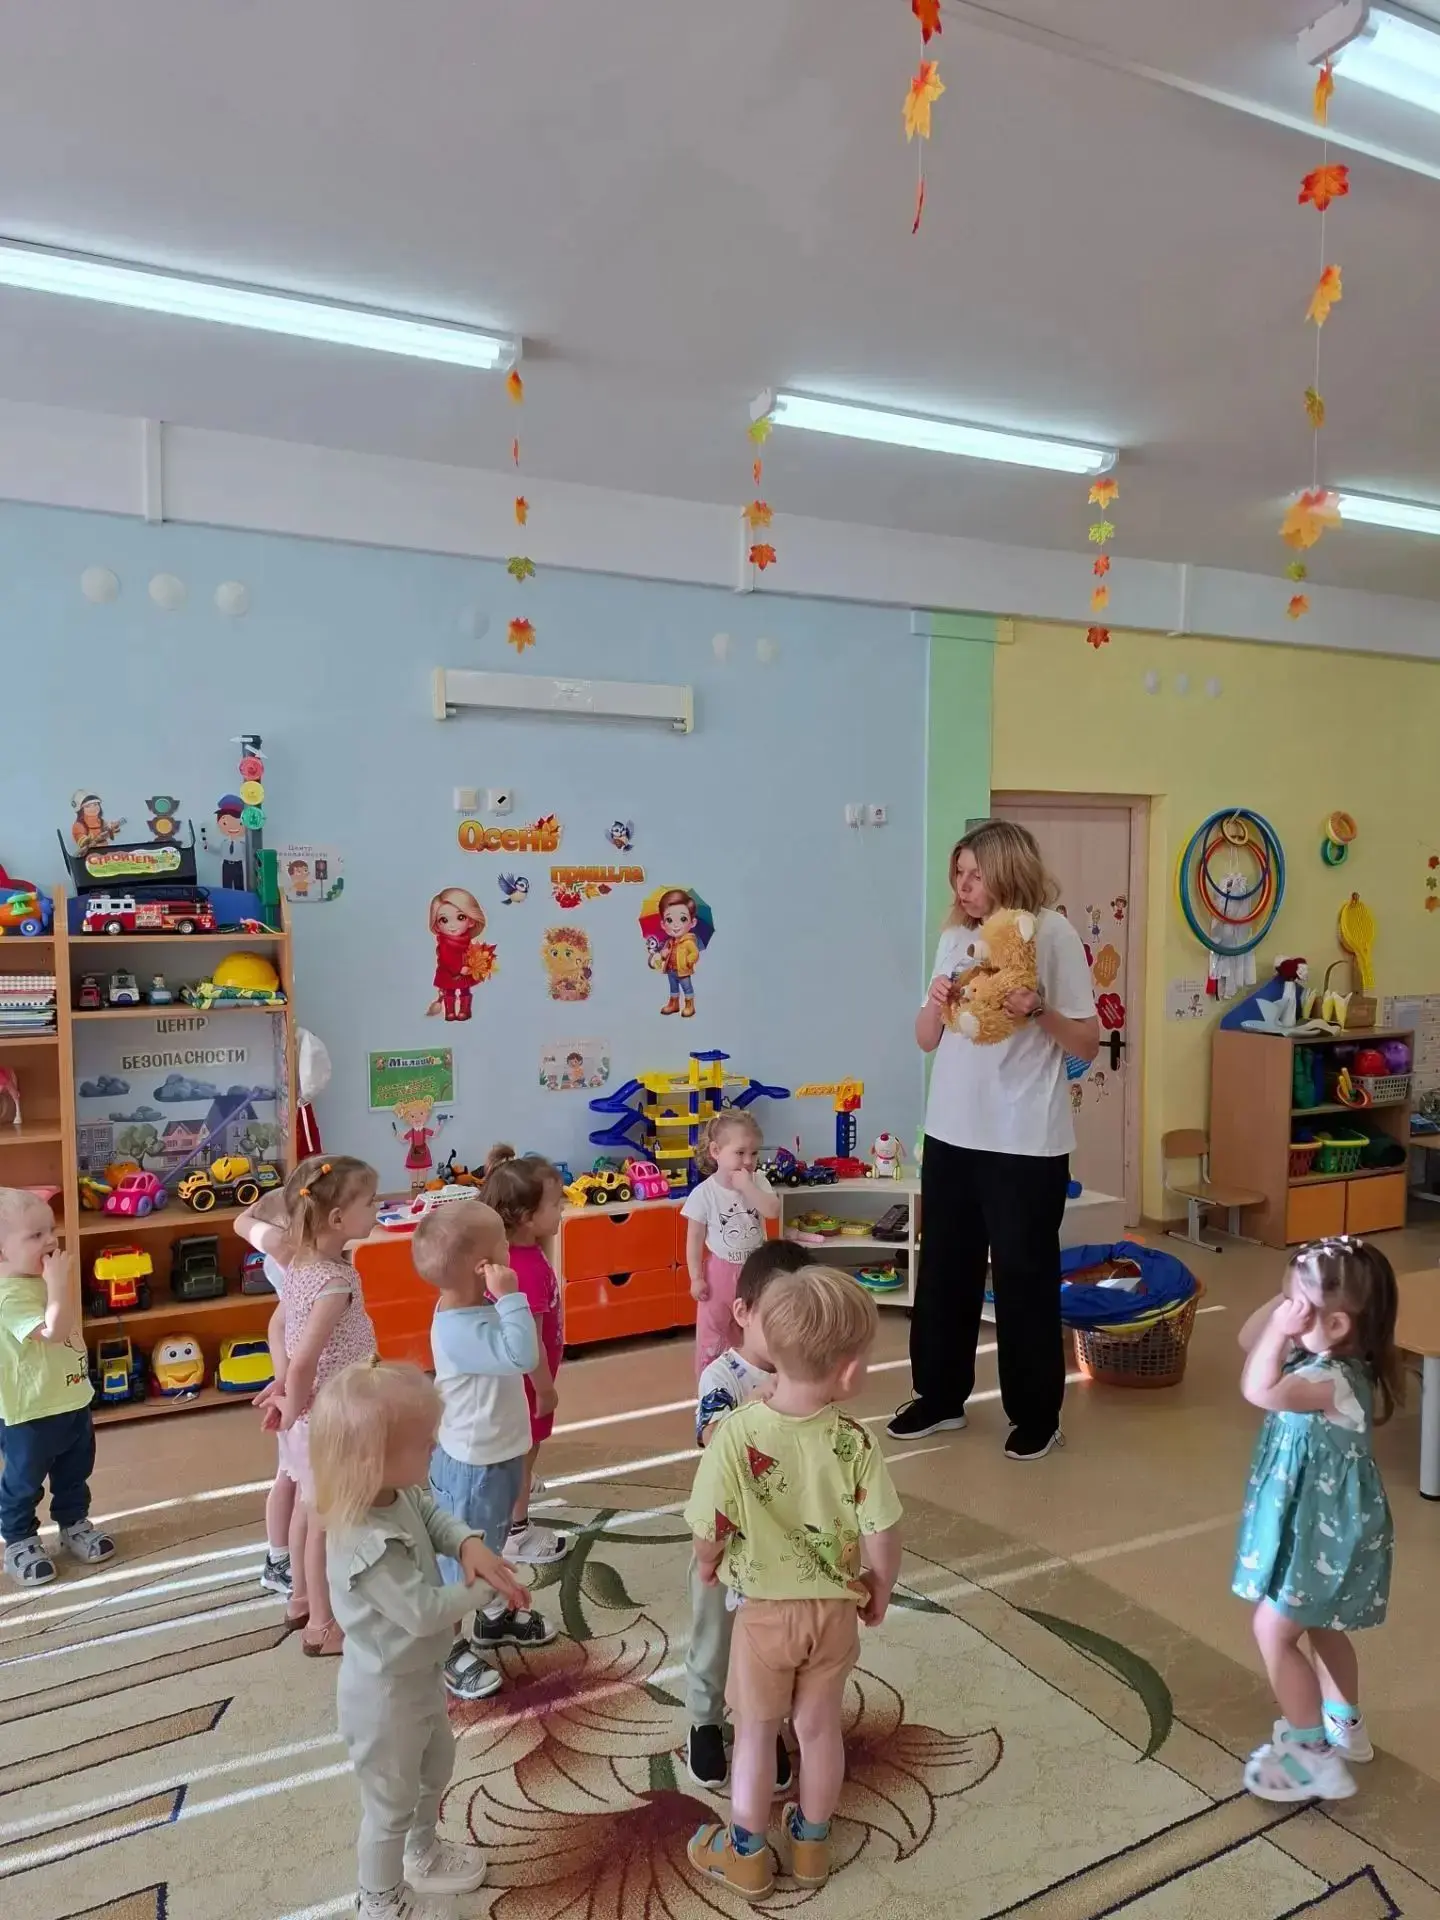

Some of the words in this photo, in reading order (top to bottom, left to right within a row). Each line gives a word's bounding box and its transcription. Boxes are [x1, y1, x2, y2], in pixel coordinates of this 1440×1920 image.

[458, 820, 560, 852] Осень
[551, 866, 645, 884] пришла
[156, 1017, 205, 1033] ЦЕНТР
[122, 1049, 245, 1069] БЕЗОПАСНОСТИ
[728, 1251, 742, 1262] BEST
